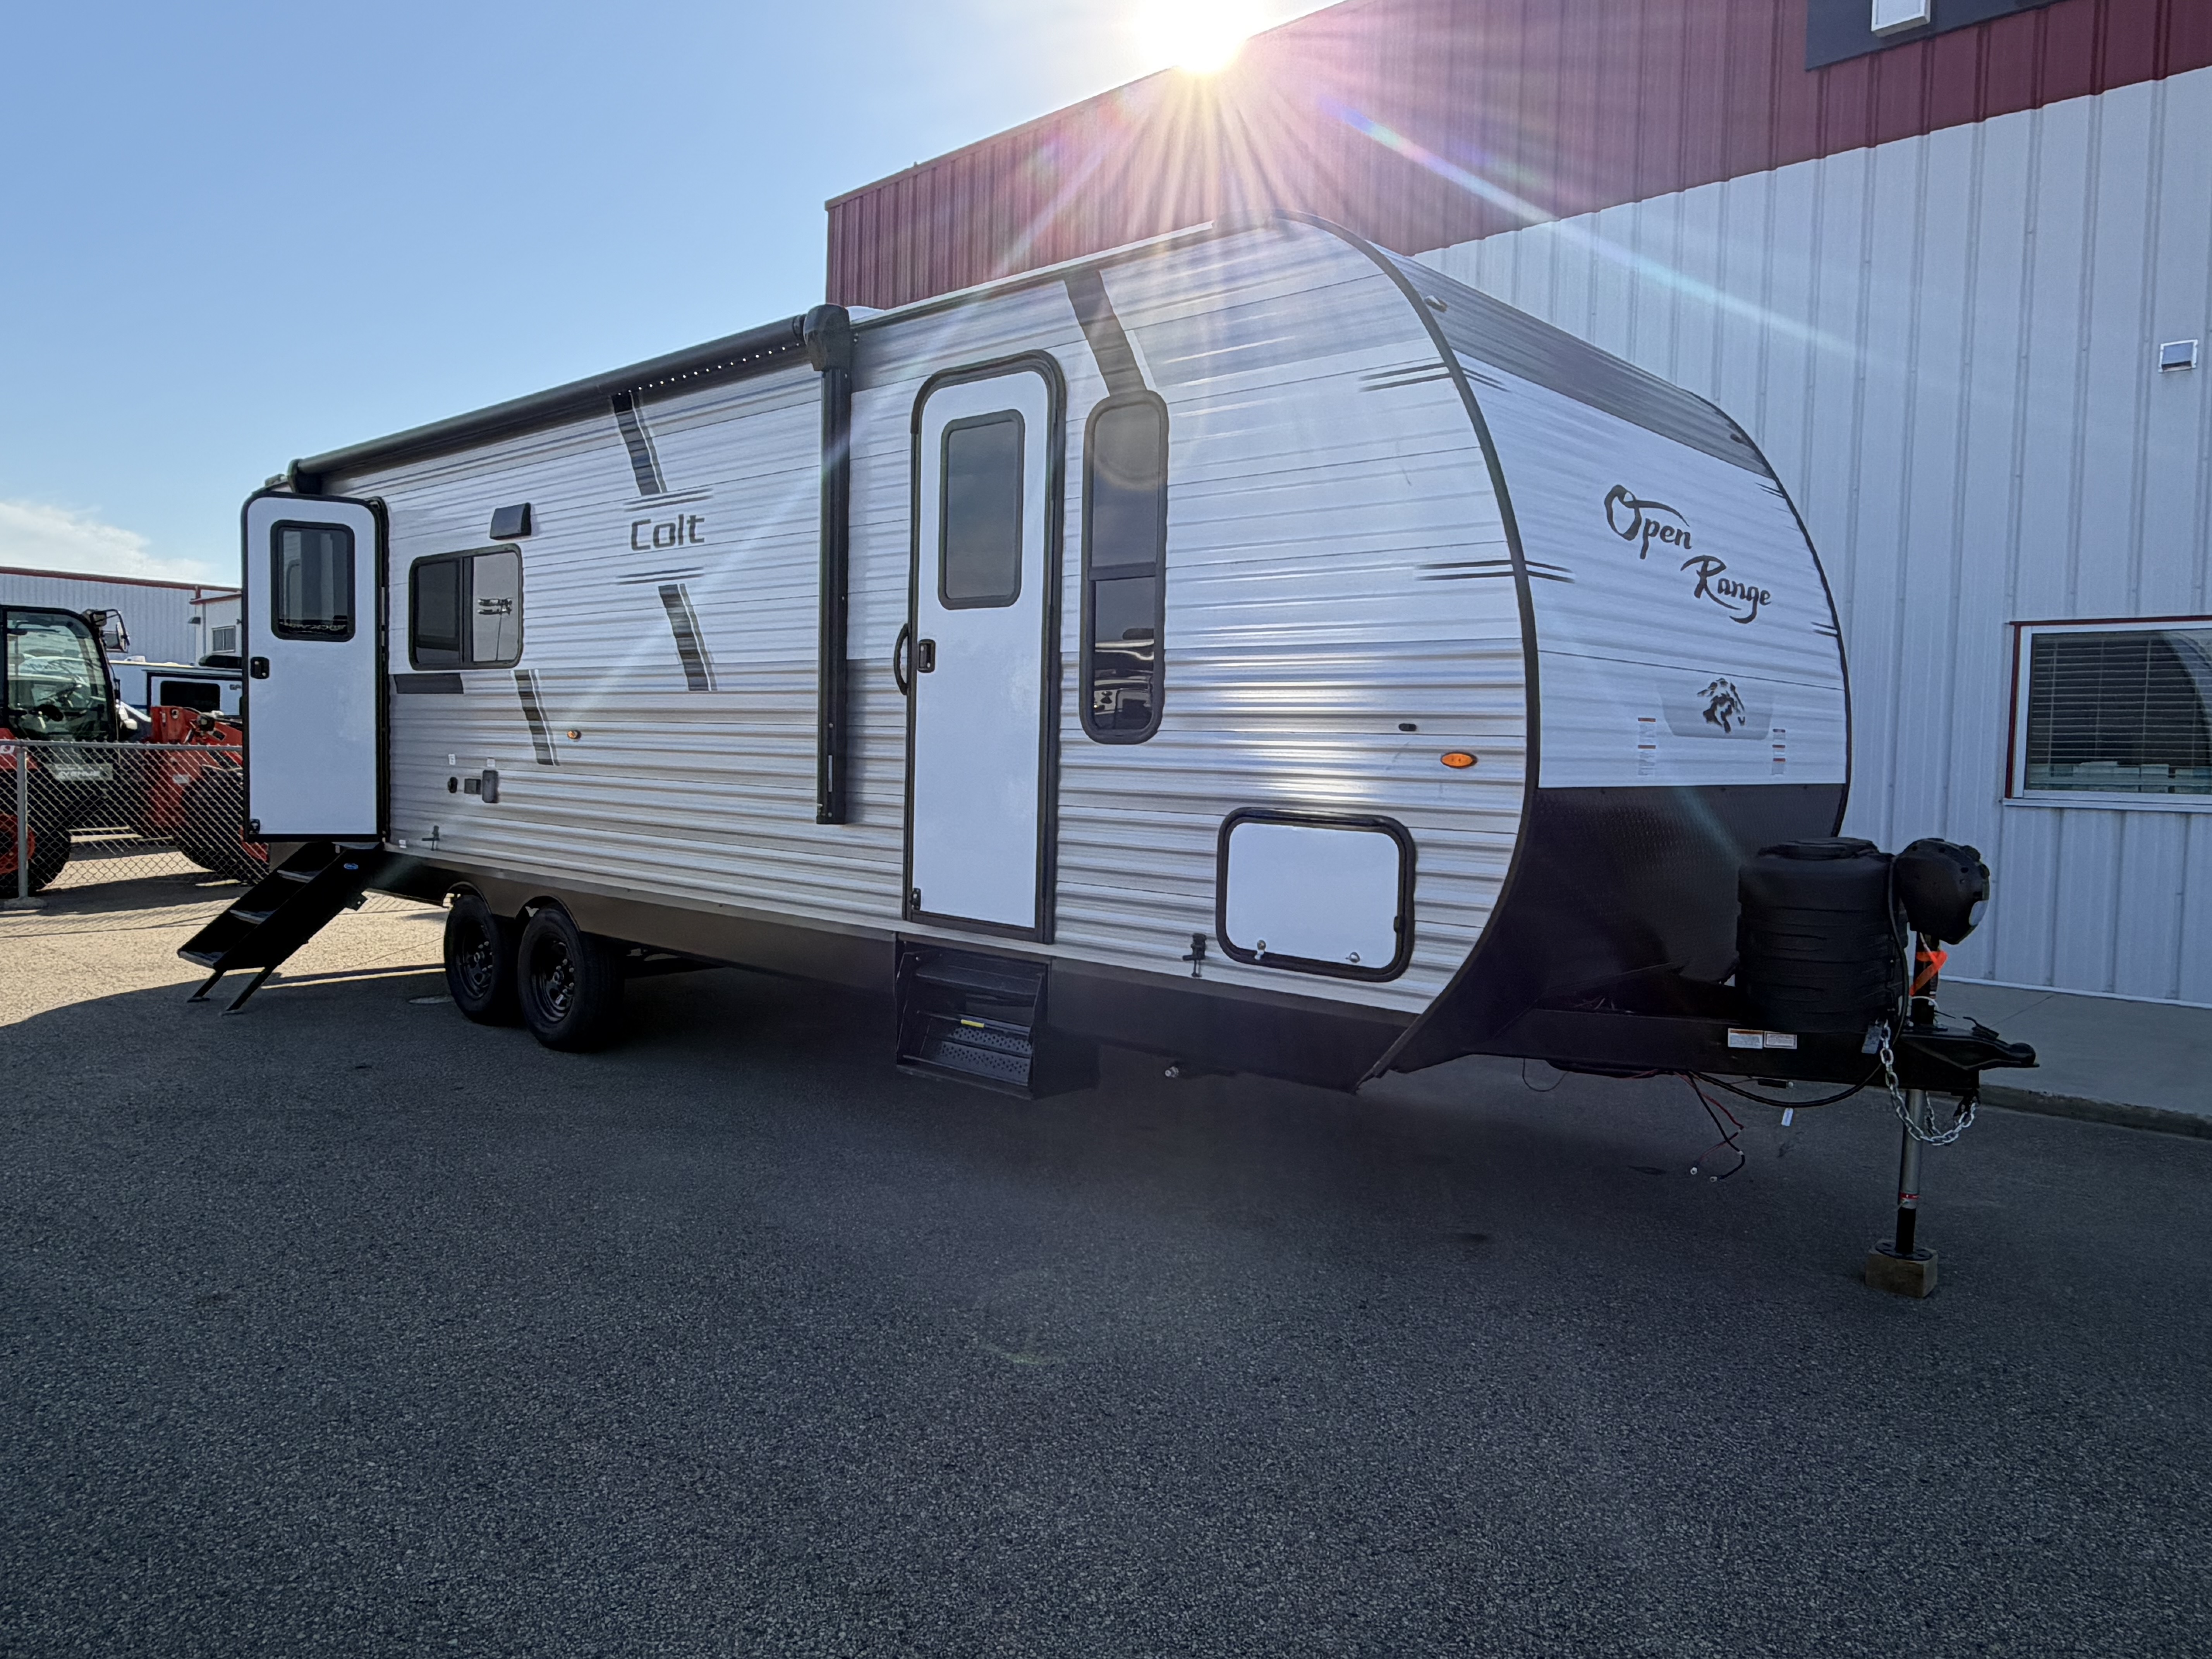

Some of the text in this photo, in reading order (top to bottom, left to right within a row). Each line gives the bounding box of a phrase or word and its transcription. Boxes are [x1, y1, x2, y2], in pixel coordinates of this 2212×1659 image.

[631, 514, 705, 551] Colt
[1604, 484, 1692, 559] Open
[1680, 555, 1772, 624] Range
